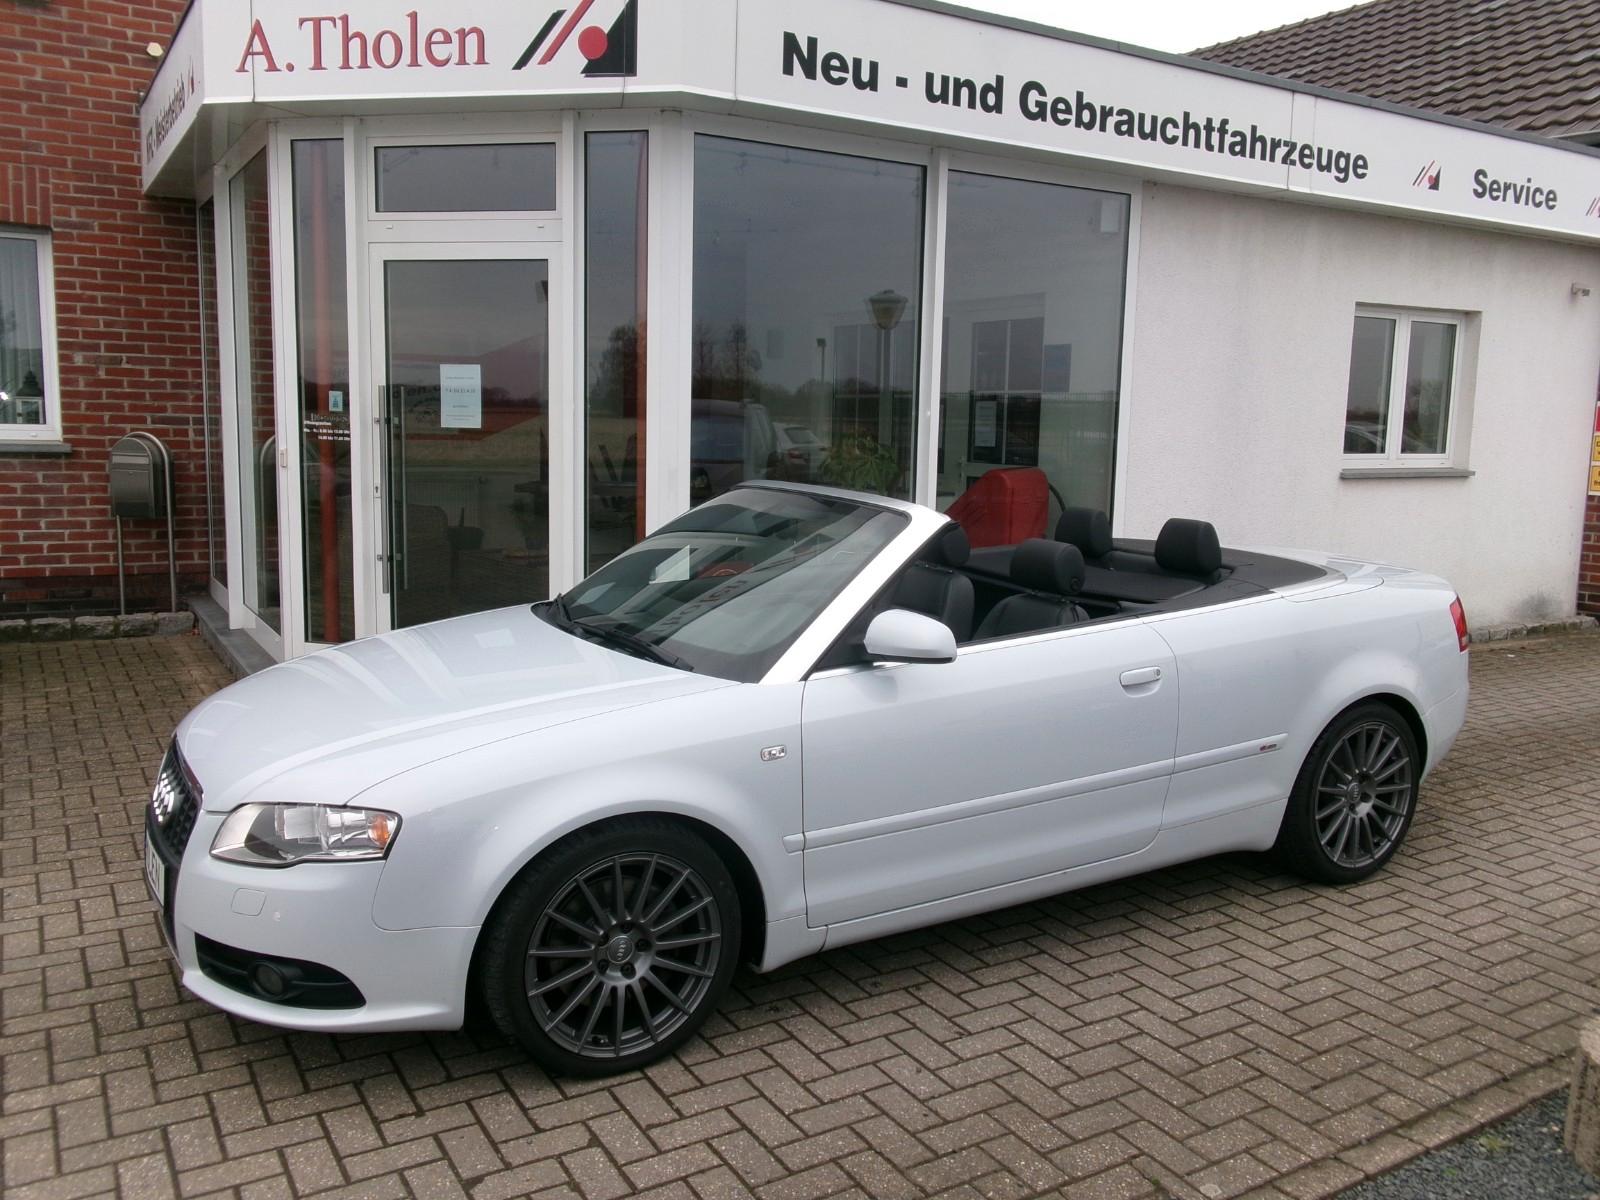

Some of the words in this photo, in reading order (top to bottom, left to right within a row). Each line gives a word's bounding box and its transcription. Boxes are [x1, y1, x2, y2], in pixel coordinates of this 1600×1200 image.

[782, 31, 879, 92] Neu
[925, 71, 1004, 114] und
[1019, 80, 1369, 183] Gebrauchtfahrzeuge
[1472, 168, 1558, 210] Service
